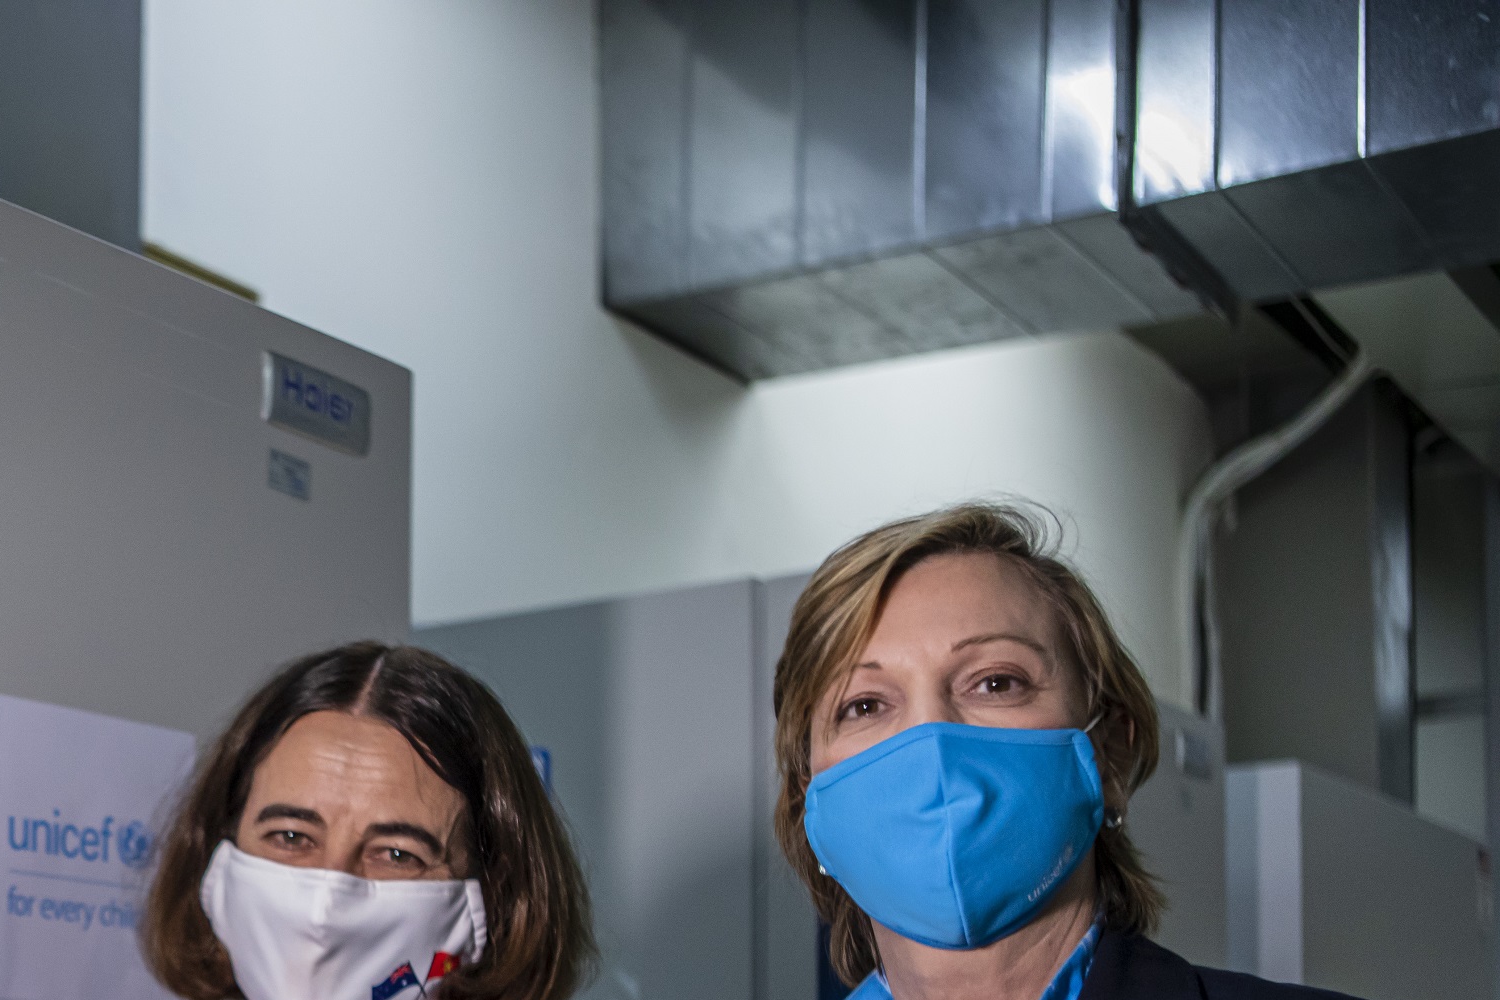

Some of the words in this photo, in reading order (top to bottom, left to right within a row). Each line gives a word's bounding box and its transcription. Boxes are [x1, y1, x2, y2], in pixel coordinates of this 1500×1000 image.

[8, 808, 114, 863] unicef
[8, 884, 34, 917] for
[40, 898, 95, 932] every
